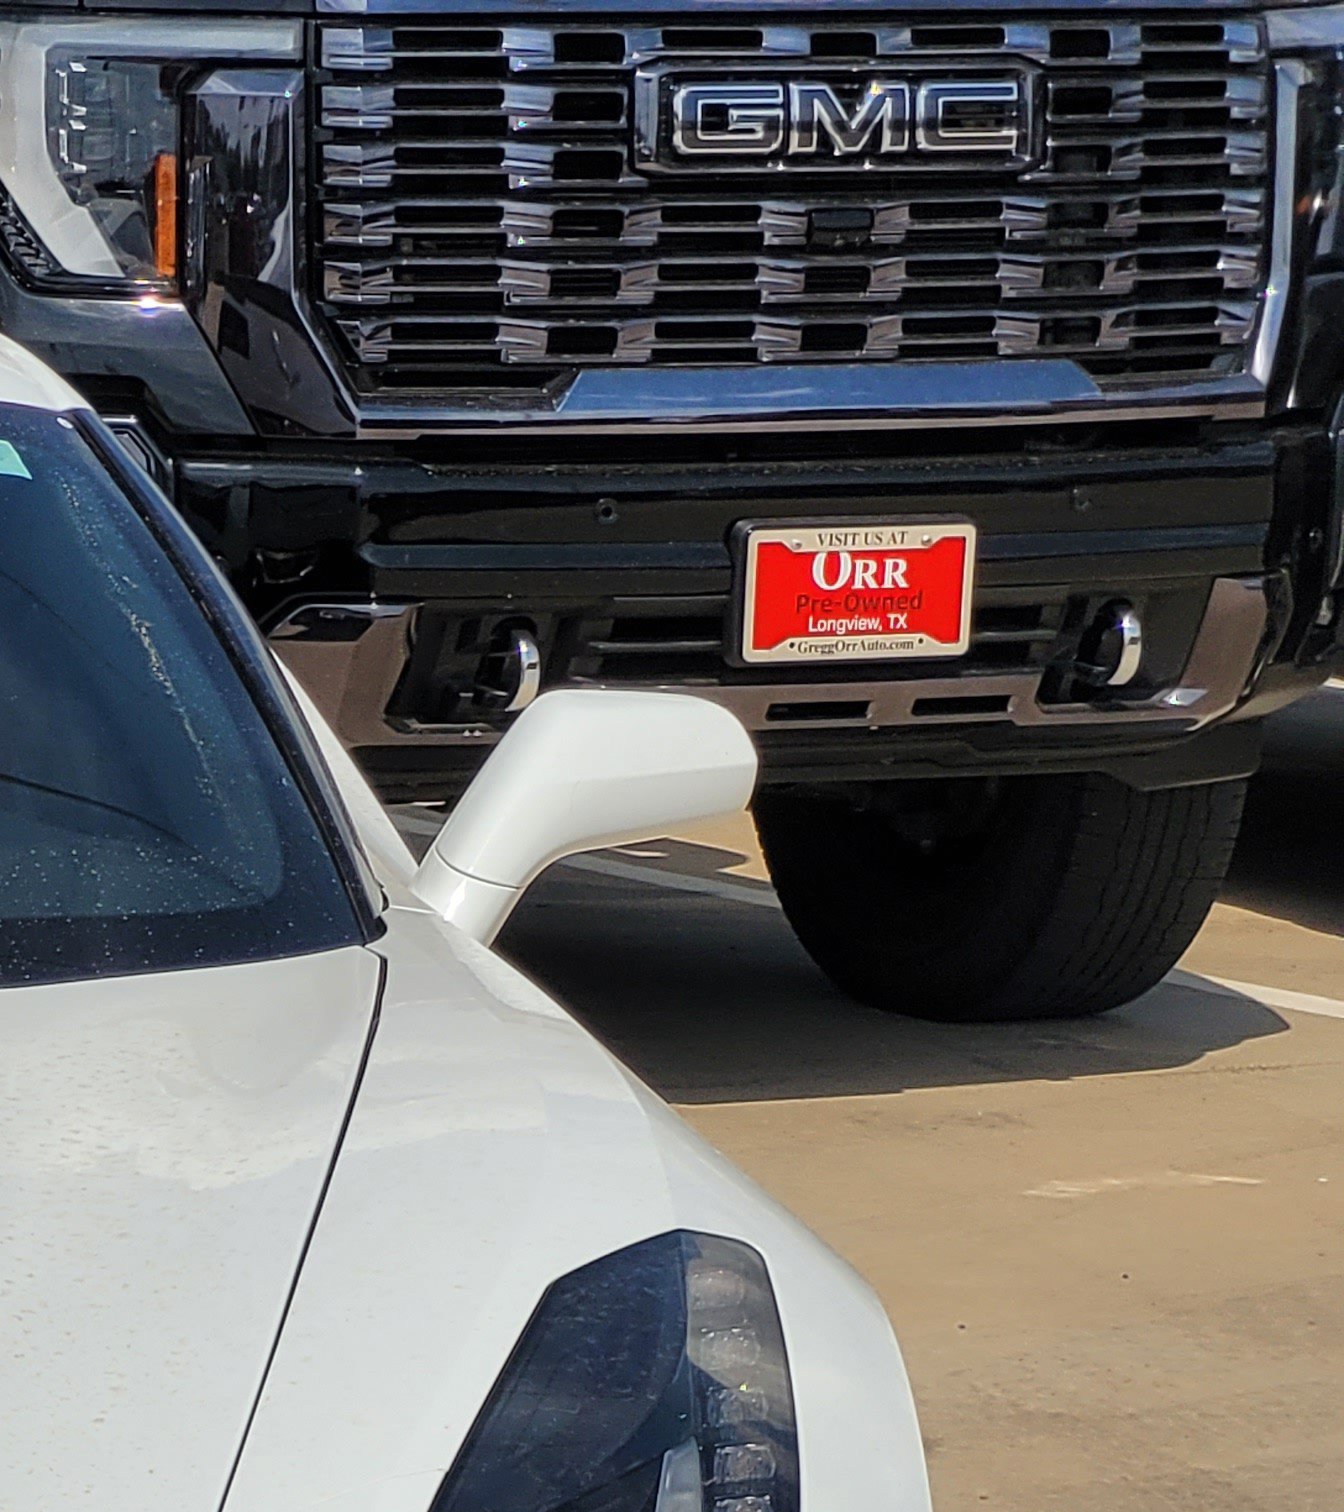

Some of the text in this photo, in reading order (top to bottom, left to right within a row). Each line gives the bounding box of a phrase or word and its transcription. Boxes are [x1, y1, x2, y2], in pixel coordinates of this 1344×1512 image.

[672, 79, 1019, 156] GMC
[817, 531, 907, 546] VISIT US AT
[796, 590, 923, 613] Pre-Owned
[808, 613, 908, 634] Longview, TX
[797, 637, 914, 655] GreggOrrAuto.com
